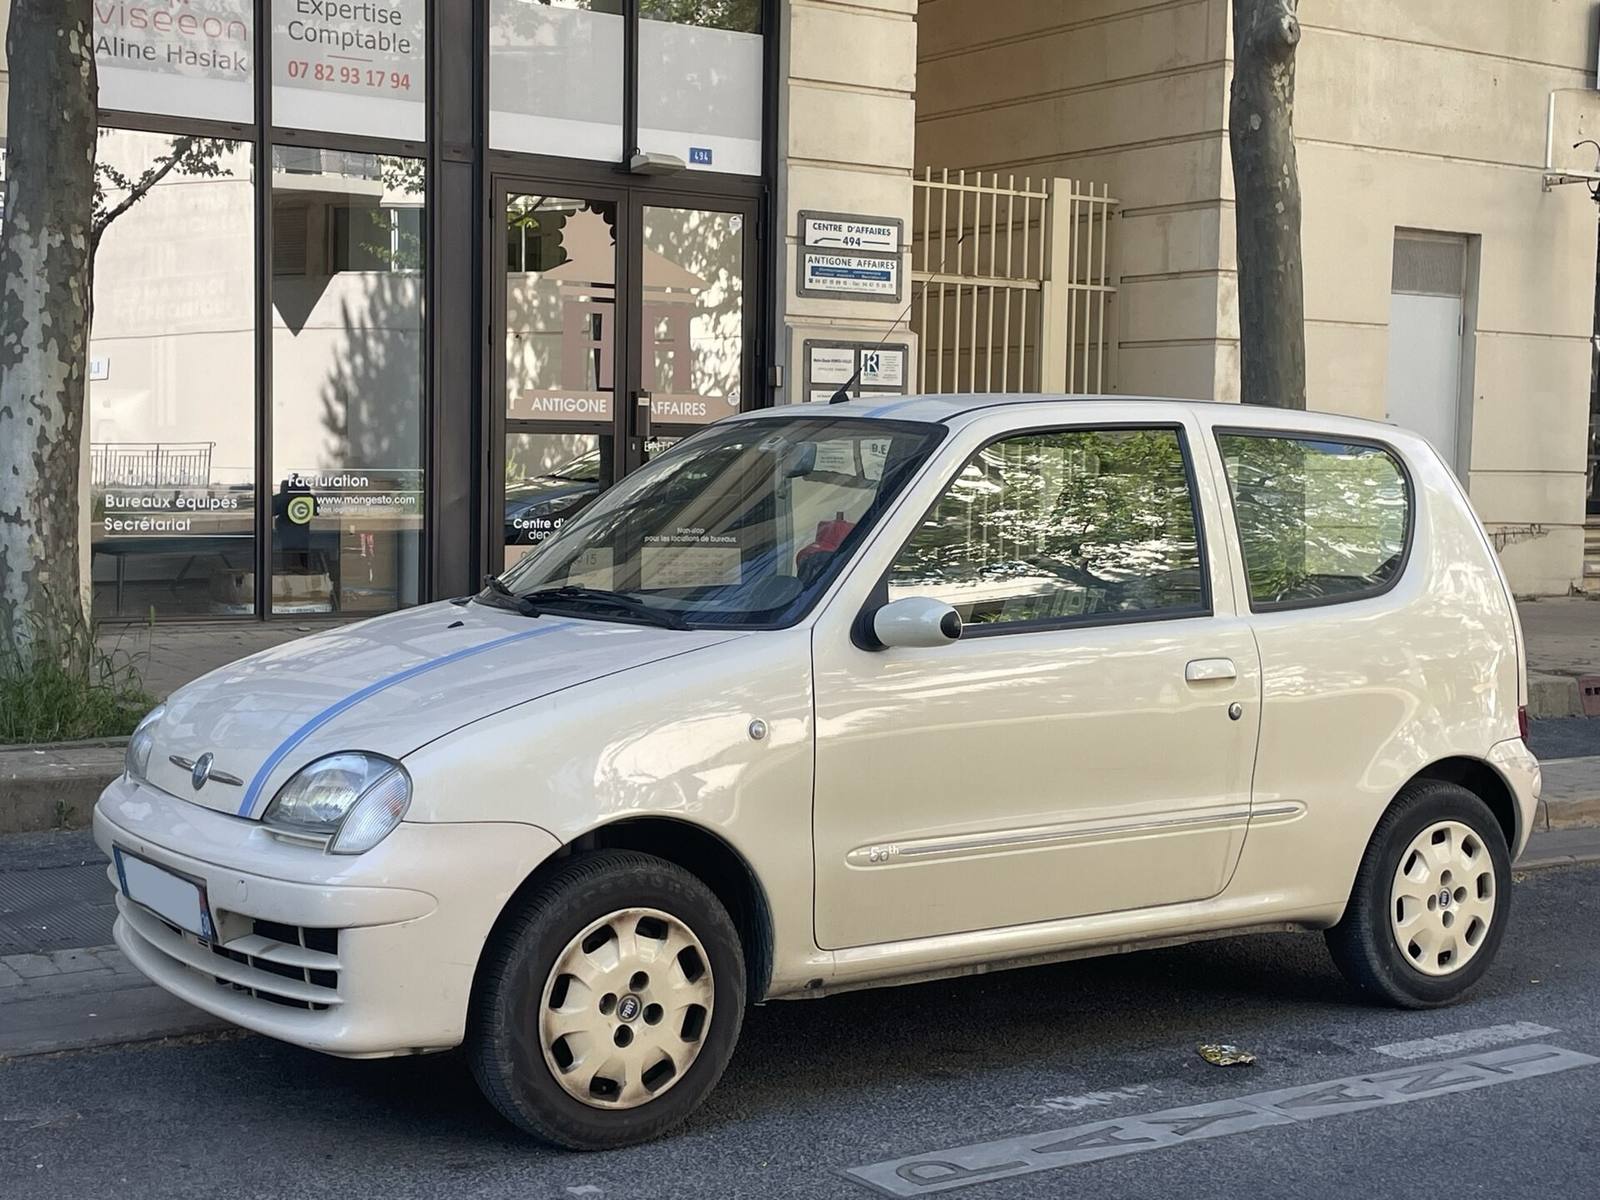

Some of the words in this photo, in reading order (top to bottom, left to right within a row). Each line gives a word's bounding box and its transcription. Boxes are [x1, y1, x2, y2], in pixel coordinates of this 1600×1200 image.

[95, 1, 247, 41] viseeon
[297, 0, 402, 26] Expertise
[288, 20, 411, 54] Comptable
[95, 36, 156, 61] Aline
[167, 44, 247, 72] Hasiak
[288, 60, 309, 79] 07
[314, 63, 335, 82] 82
[340, 66, 360, 85] 93
[366, 69, 385, 87] 17
[390, 72, 411, 90] 94
[813, 222, 843, 233] CENTRE
[847, 226, 891, 237] D'AFFAIRES
[842, 236, 861, 247] 494
[808, 255, 852, 267] ANTIGONE
[856, 259, 895, 270] AFFAIRES
[531, 397, 607, 413] ANTIGONE
[651, 401, 706, 416] AFFAIRES
[105, 494, 171, 509] Bureaux
[175, 494, 238, 511] équipés
[316, 495, 415, 507] www.mongesto.com
[104, 516, 192, 531] Secrétariat
[513, 518, 552, 529] Centre
